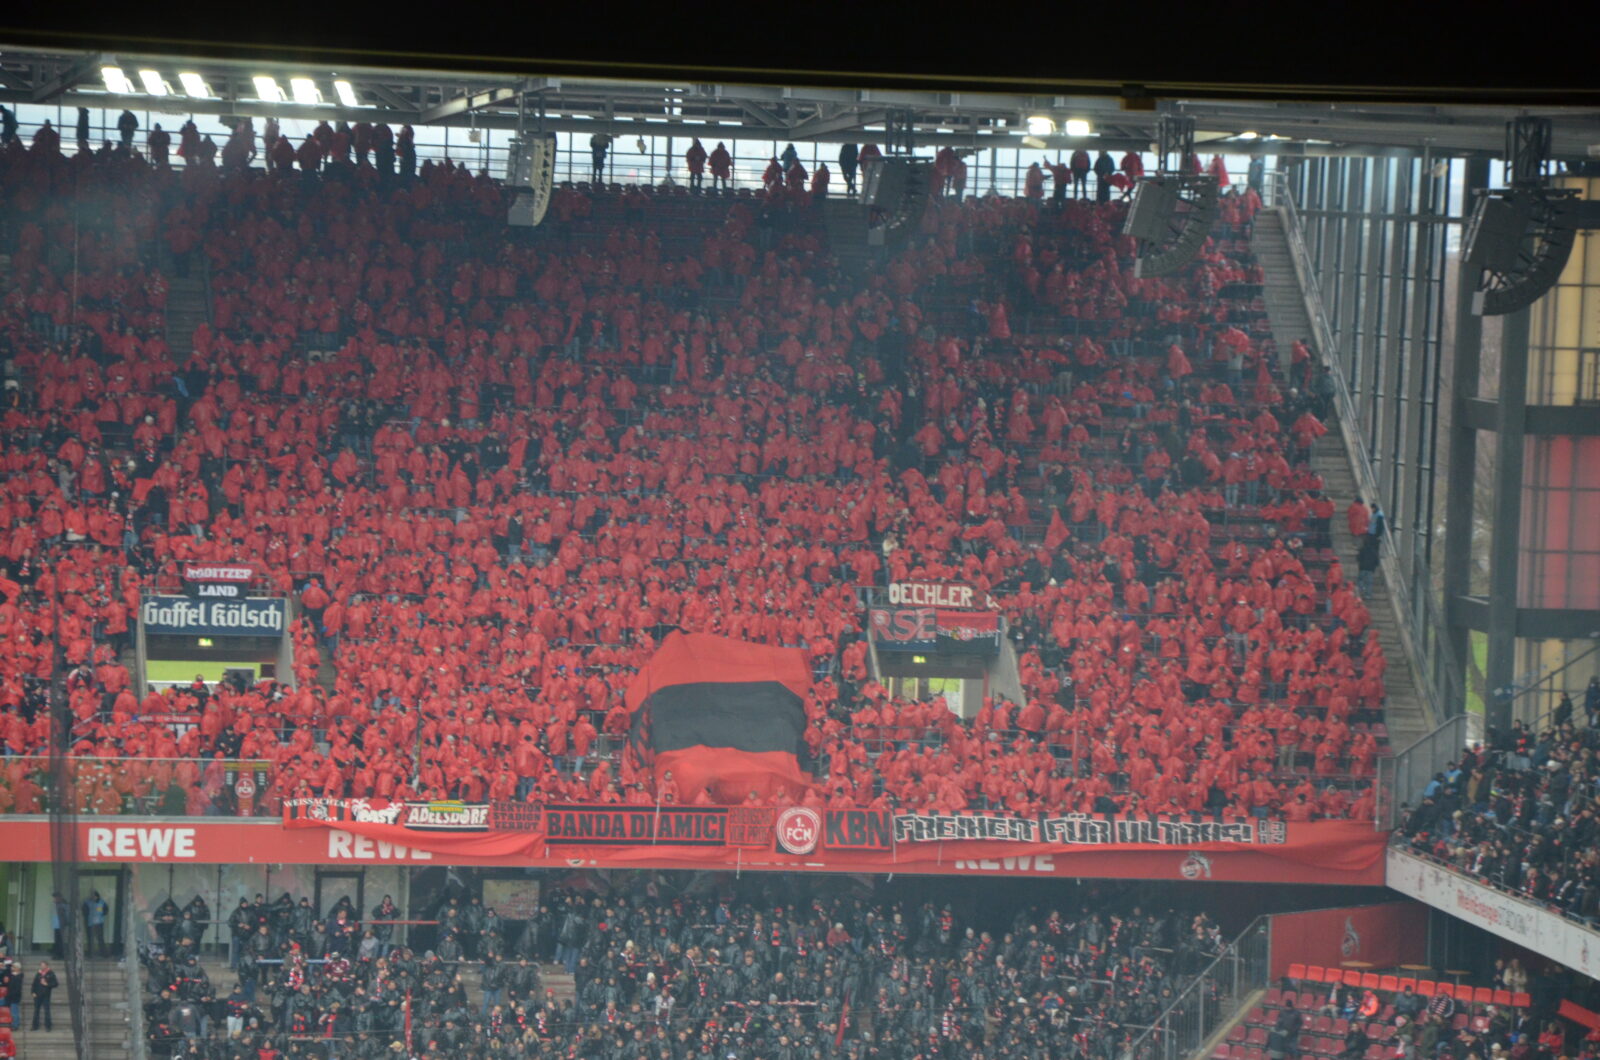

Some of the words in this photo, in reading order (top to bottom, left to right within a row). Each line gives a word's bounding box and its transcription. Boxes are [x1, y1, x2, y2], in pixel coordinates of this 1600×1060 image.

[198, 585, 238, 597] LAND
[888, 583, 973, 607] OECHLER
[143, 601, 207, 628] Gaffel
[211, 602, 282, 631] Kölsch
[869, 607, 937, 641] RSE
[408, 807, 488, 824] ADELSDORF
[547, 812, 626, 838] BANDA
[630, 814, 655, 838] DI
[658, 814, 727, 839] AMICI
[826, 810, 891, 847] KBN
[892, 814, 1039, 842] FREIHEIT
[88, 828, 197, 857] REWE
[786, 827, 813, 841] FCN
